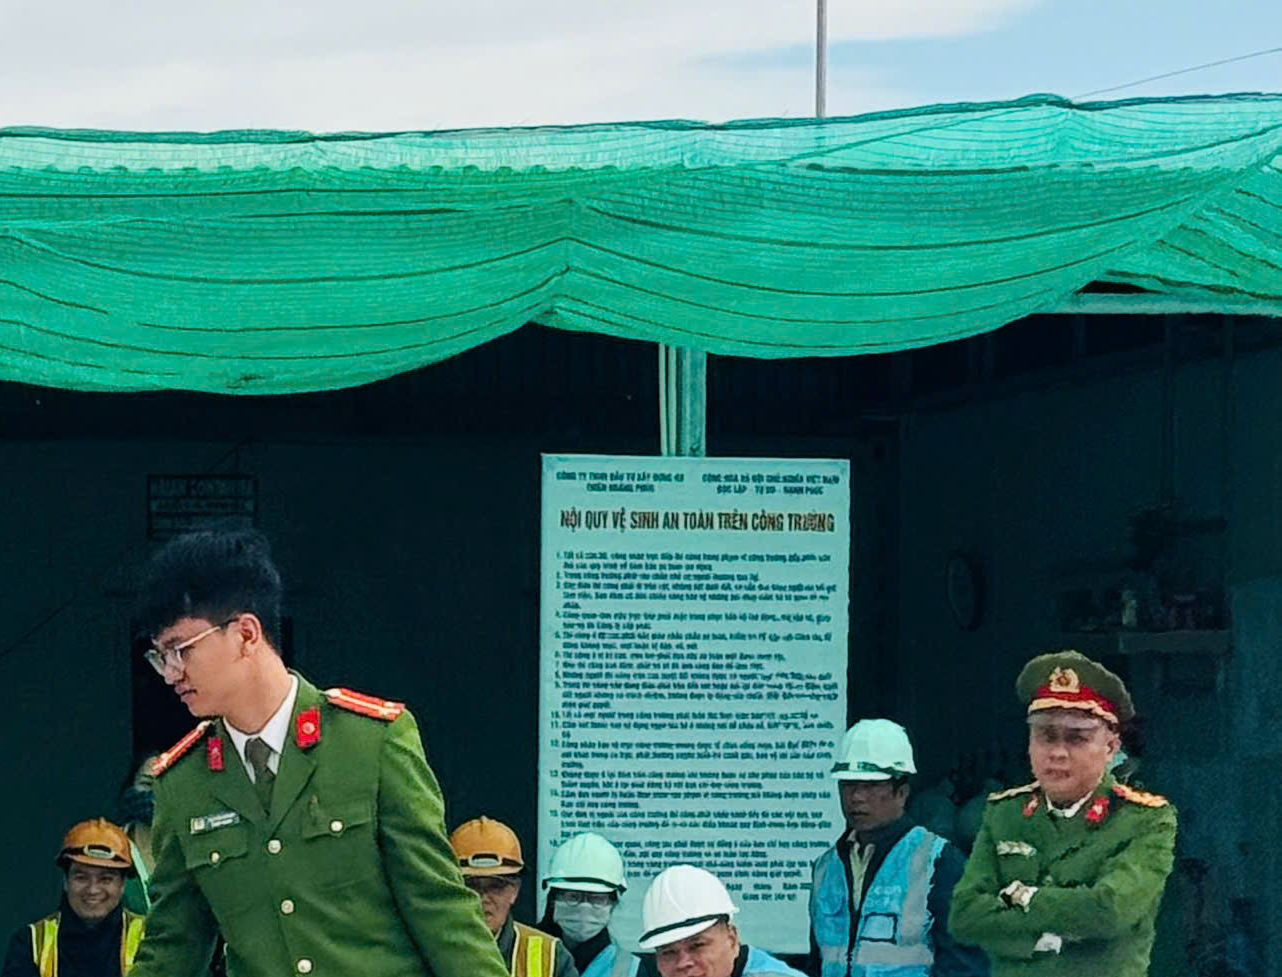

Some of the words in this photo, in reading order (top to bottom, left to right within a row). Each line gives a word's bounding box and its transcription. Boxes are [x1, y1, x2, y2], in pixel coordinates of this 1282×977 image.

[560, 507, 582, 533] NỘI
[585, 510, 608, 530] QUY
[612, 506, 627, 533] VỆ
[630, 511, 659, 530] SINH
[663, 511, 679, 530] AN
[683, 508, 714, 530] TOÀN
[717, 508, 748, 531] TRÊN
[751, 508, 784, 532] CÔNG
